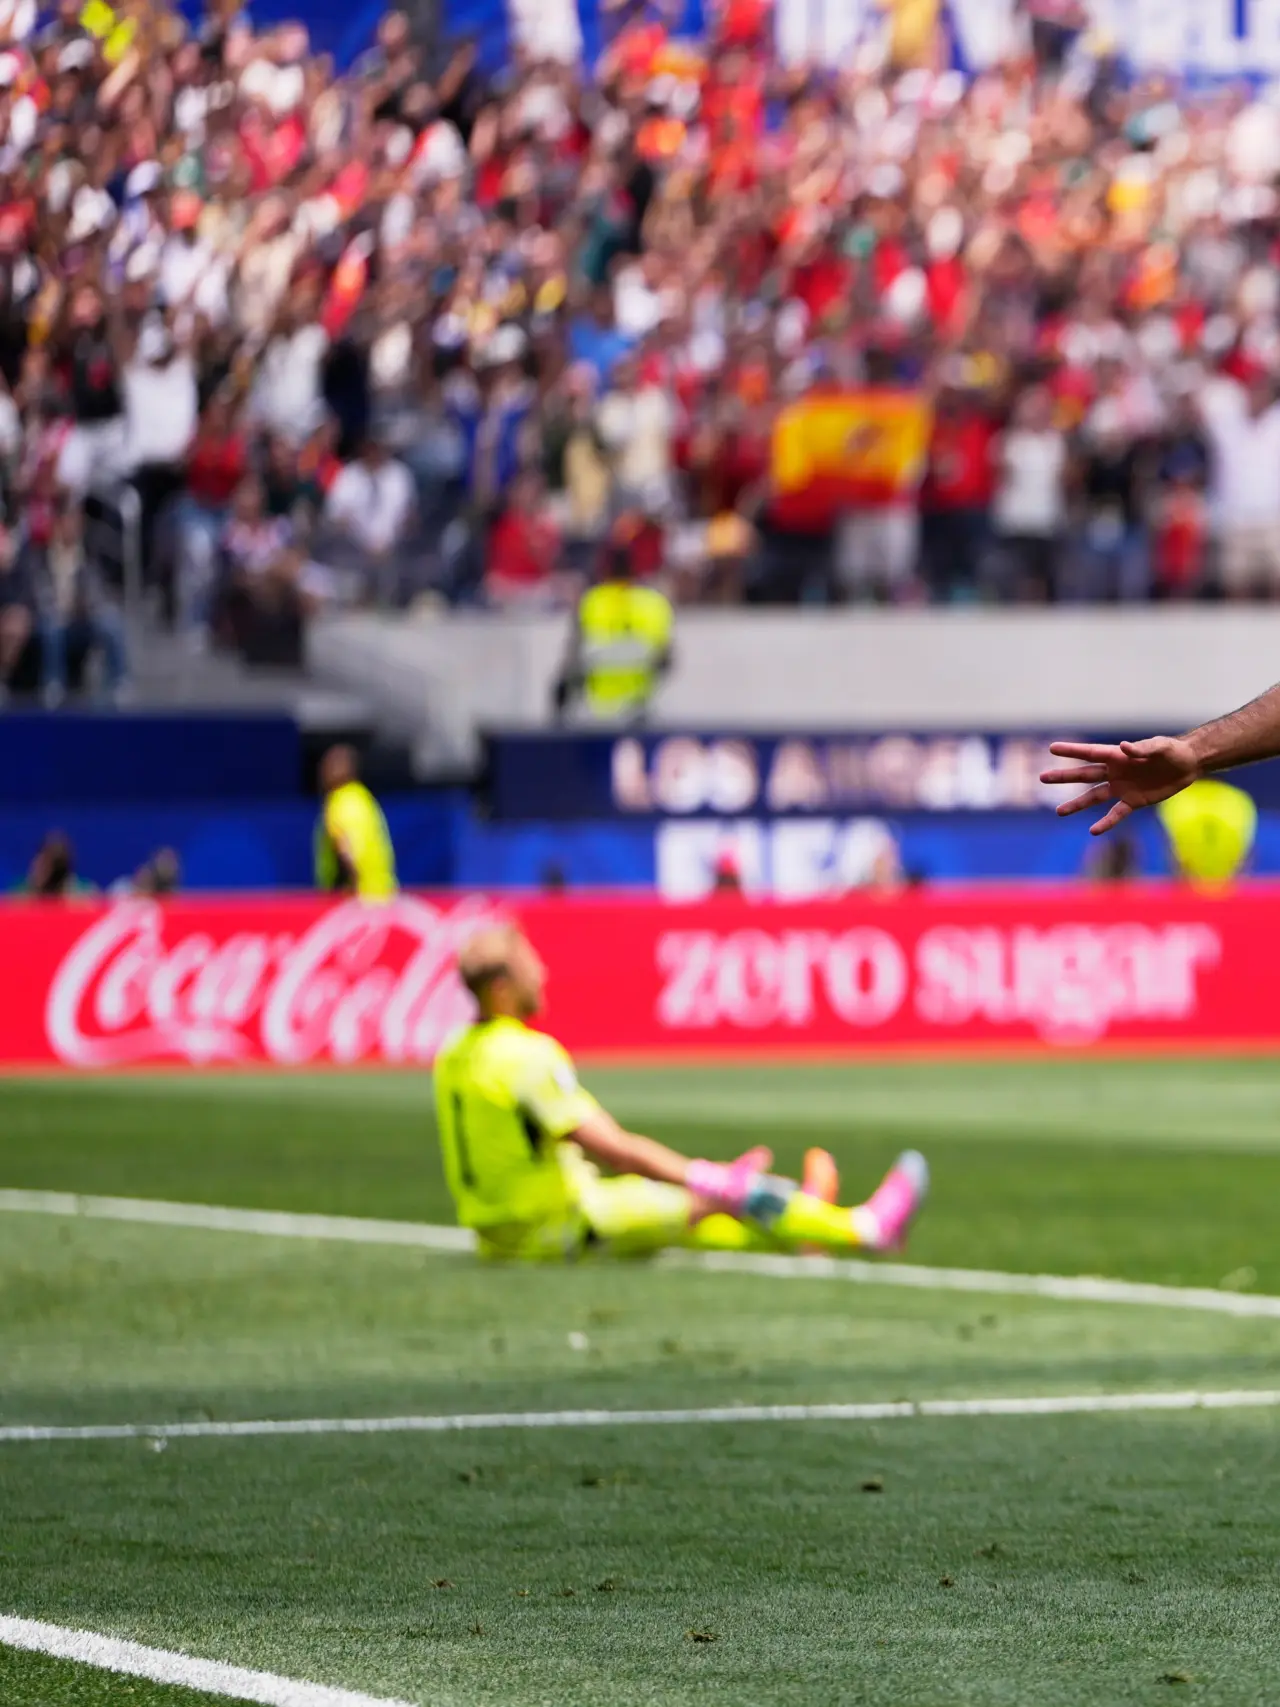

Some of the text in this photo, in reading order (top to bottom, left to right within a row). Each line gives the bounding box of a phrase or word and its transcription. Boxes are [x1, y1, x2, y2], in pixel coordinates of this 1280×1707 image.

[612, 736, 758, 812] LOS
[655, 926, 906, 1029] zero
[914, 922, 1222, 1046] sugar
